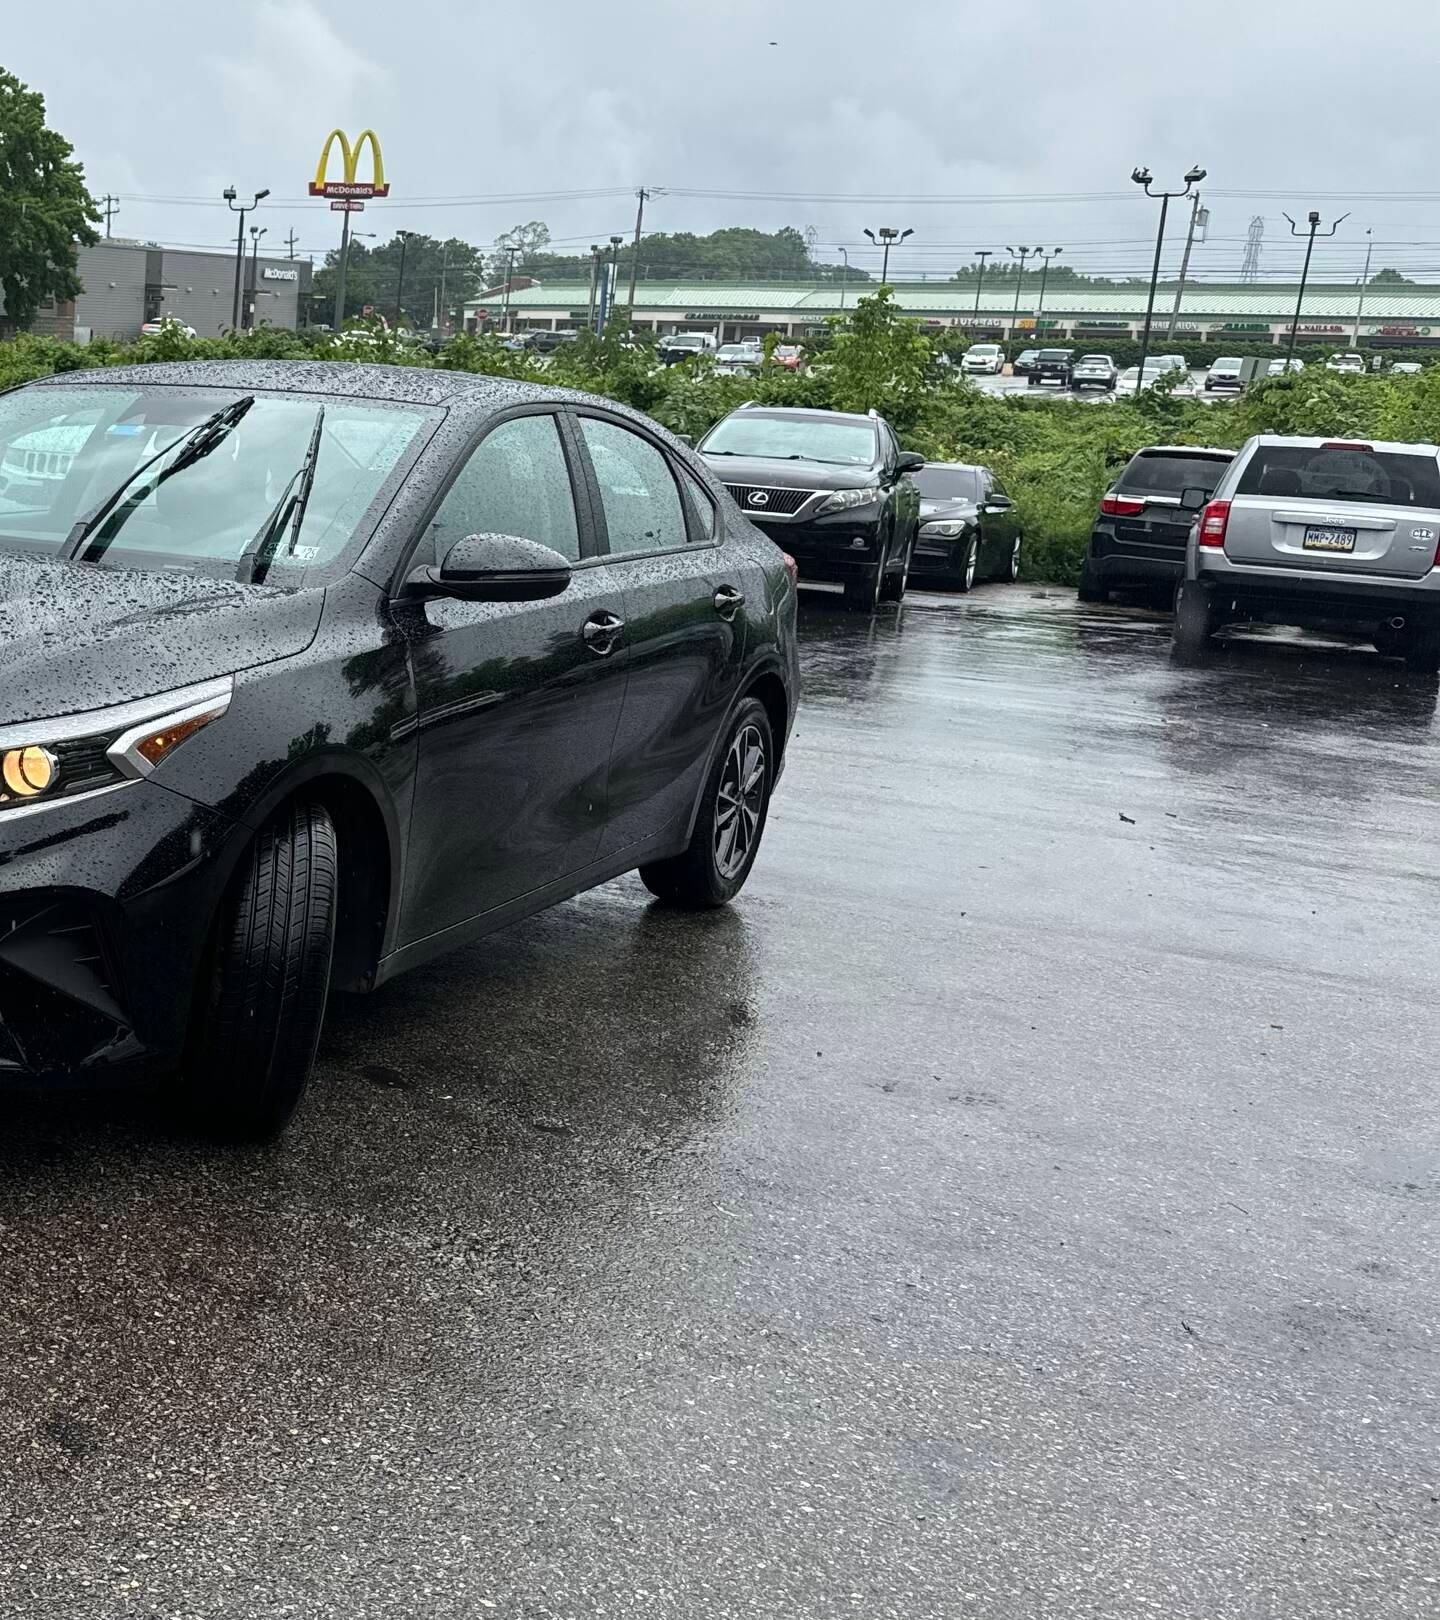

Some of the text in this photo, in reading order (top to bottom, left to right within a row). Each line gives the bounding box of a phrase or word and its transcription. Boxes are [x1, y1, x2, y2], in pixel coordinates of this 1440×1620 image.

[326, 186, 373, 195] McDonald's
[263, 267, 298, 281] McDonald's
[1174, 321, 1199, 330] ALON
[1322, 516, 1345, 526] Jeep
[1412, 528, 1432, 539] CLE
